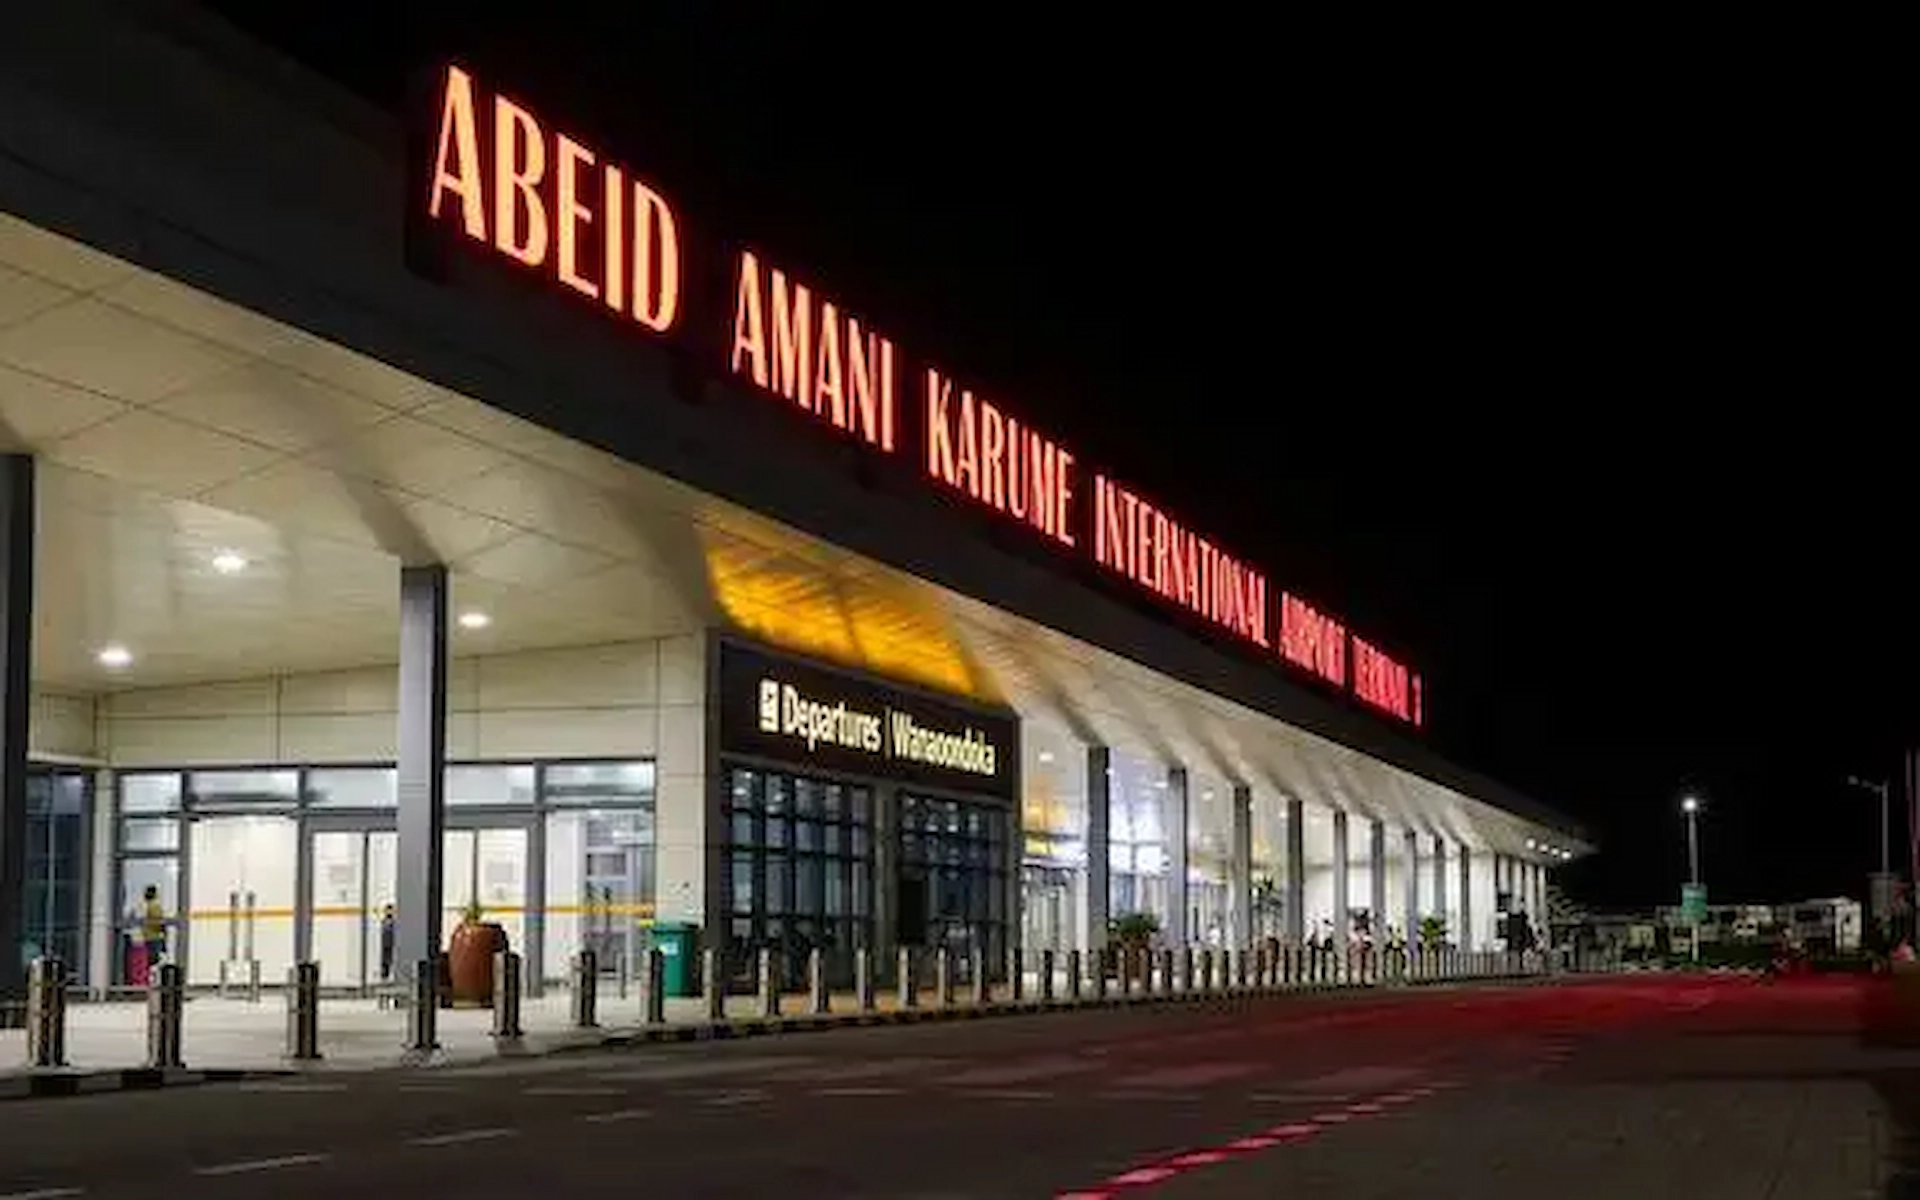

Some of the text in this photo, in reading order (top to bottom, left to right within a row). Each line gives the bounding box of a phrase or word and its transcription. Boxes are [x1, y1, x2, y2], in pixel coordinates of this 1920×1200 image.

[430, 66, 678, 332] ABEID
[732, 252, 894, 453] AMANI
[928, 369, 1074, 547] KARUME
[1096, 475, 1270, 648] INTERNATIONAL
[1279, 591, 1346, 686] AIRPORT
[782, 684, 882, 752] Departures
